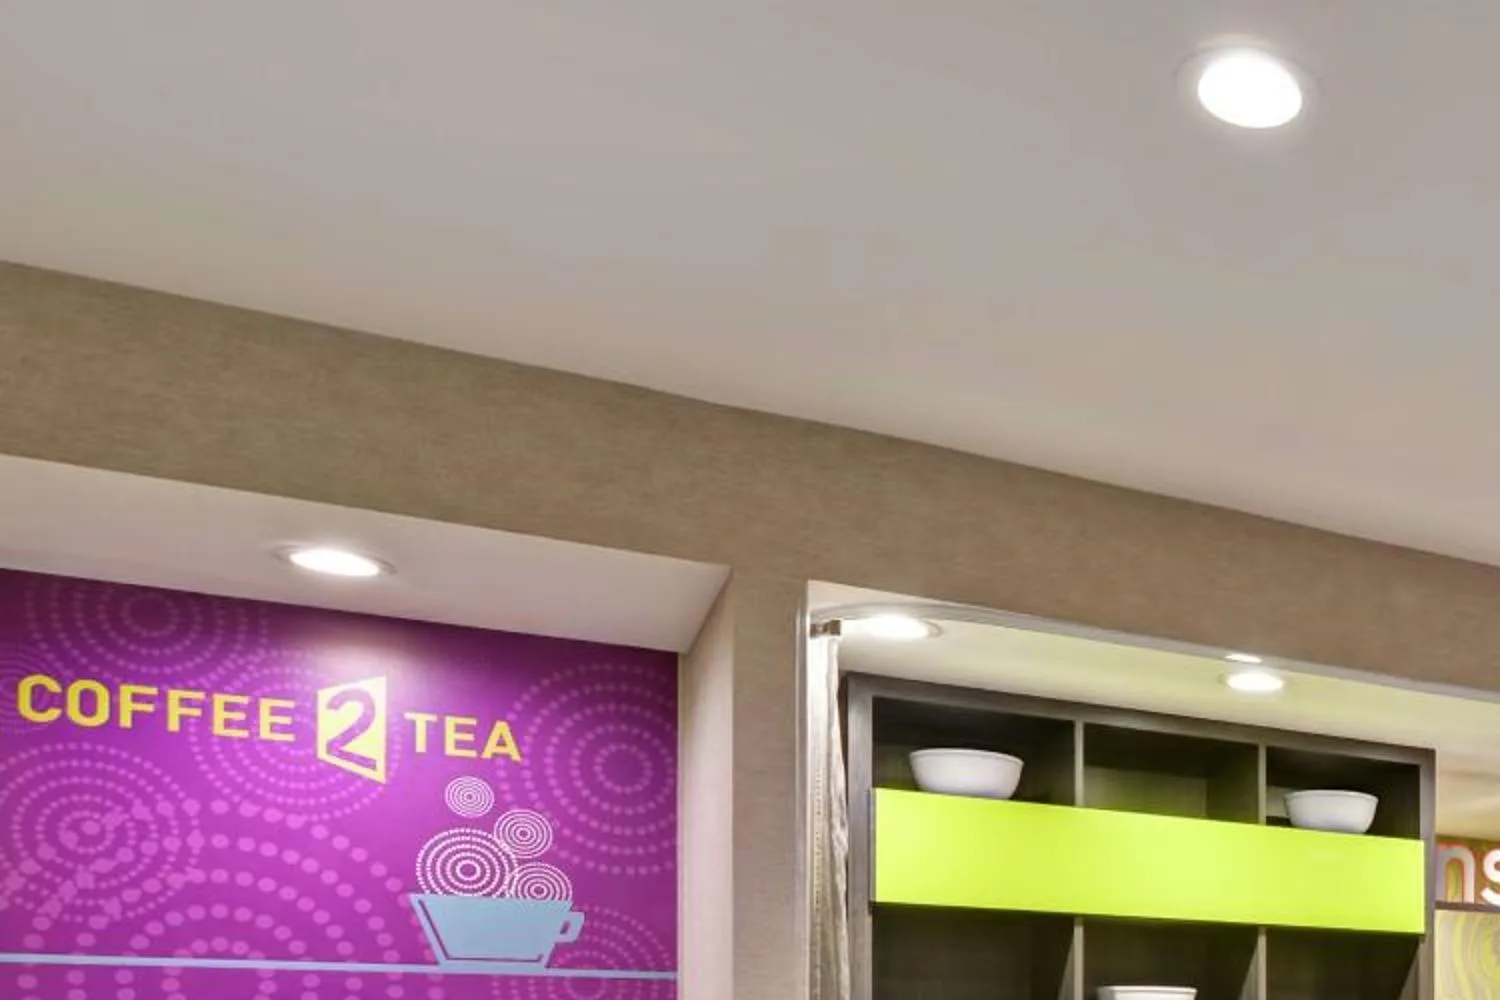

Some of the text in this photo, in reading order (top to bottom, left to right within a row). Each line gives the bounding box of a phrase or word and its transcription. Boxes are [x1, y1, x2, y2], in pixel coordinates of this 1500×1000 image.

[16, 674, 523, 771] COFFEE 2 TEA
